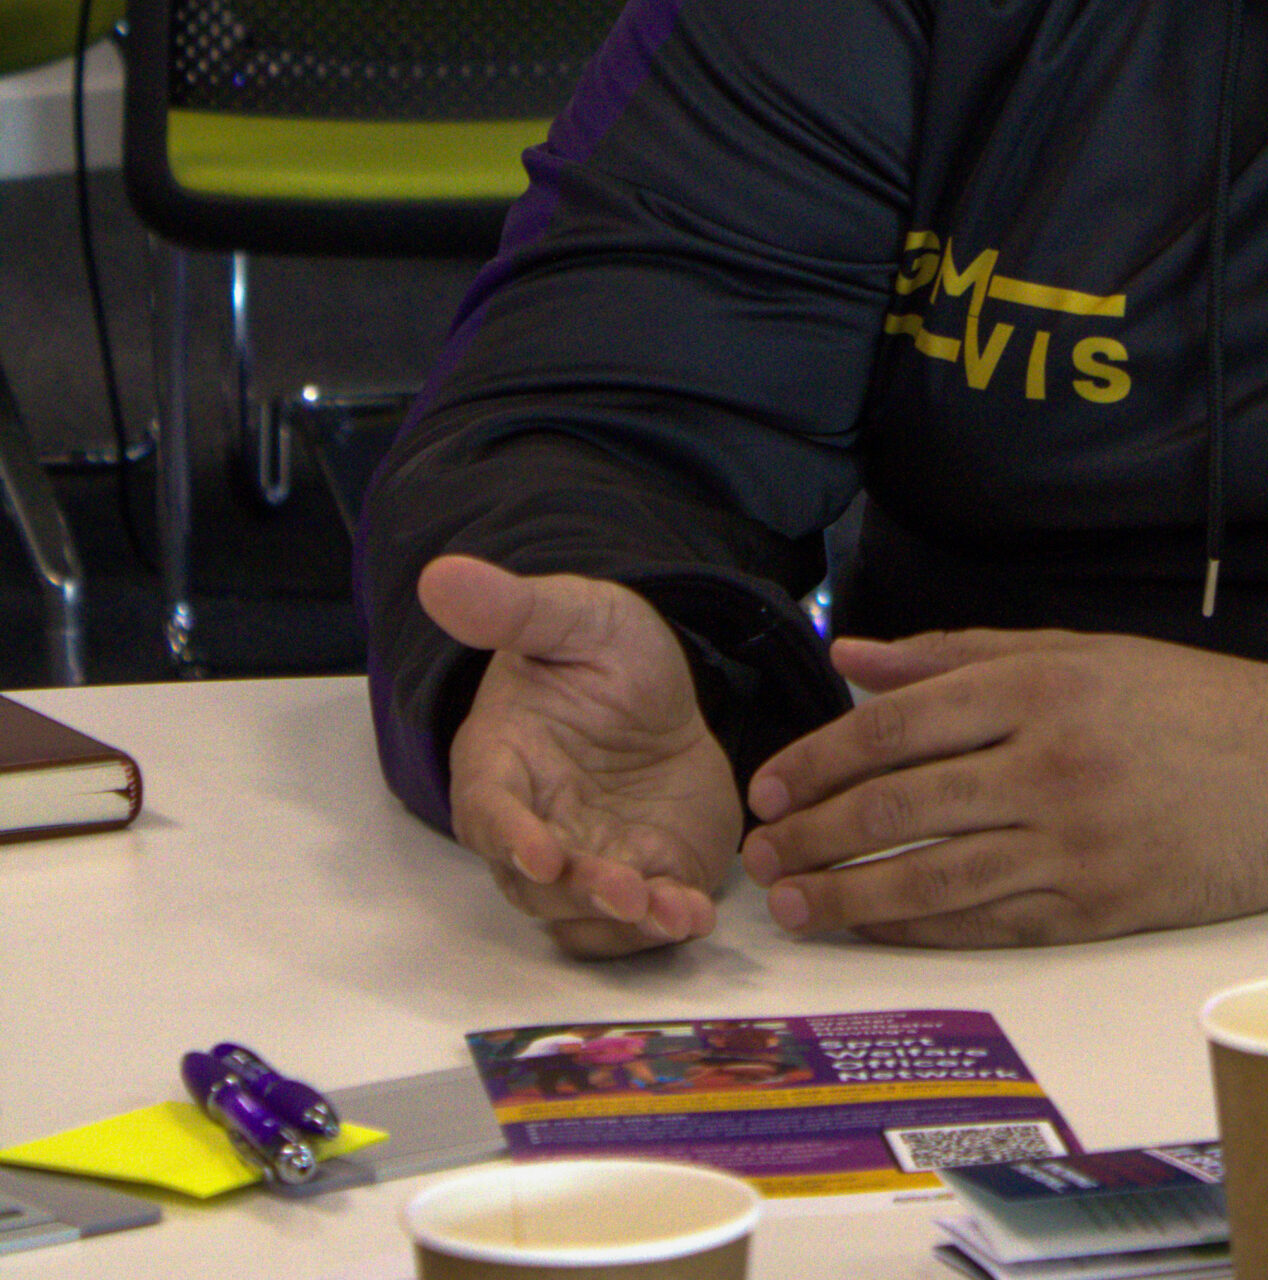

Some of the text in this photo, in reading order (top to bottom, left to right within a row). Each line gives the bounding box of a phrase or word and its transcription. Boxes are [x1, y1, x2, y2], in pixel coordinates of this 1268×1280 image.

[963, 316, 1133, 405] VIS
[812, 1022, 944, 1032] Manchester
[818, 1036, 935, 1050] Sport
[824, 1046, 989, 1060] Welfare
[831, 1058, 977, 1071] Officer
[837, 1068, 1020, 1082] Network
